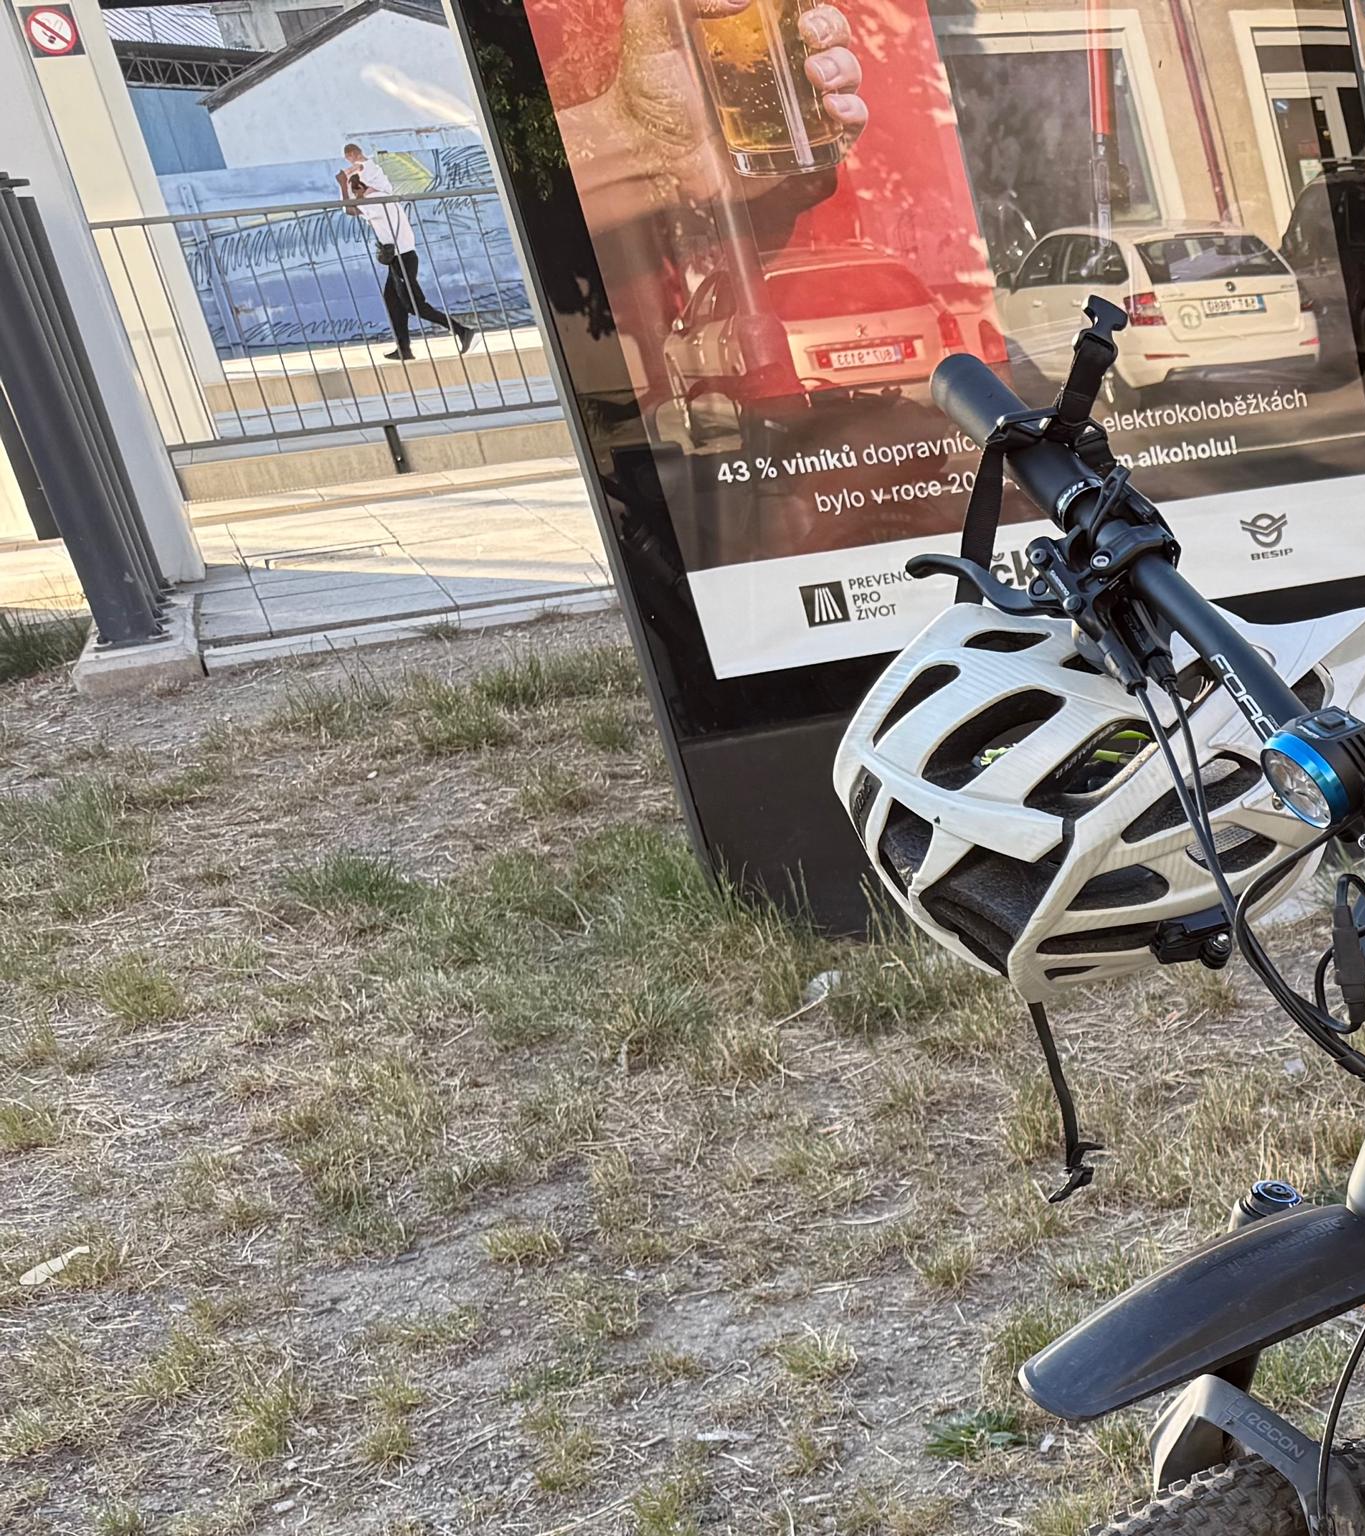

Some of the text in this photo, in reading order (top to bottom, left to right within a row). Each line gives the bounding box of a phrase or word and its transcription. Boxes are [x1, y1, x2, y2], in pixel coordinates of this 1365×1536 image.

[1103, 388, 1308, 433] elektrokoloběžkách
[717, 430, 981, 484] 43 % viníků dopravníc
[1137, 434, 1238, 468] alkoholu!
[813, 488, 865, 516] bylo
[870, 487, 891, 505] v
[892, 478, 942, 503] roce
[1250, 547, 1294, 561] BESIP
[848, 570, 914, 591] PREVENC
[852, 591, 881, 606] PRO
[855, 602, 897, 621] ŽIVOT
[1209, 652, 1279, 742] FORC
